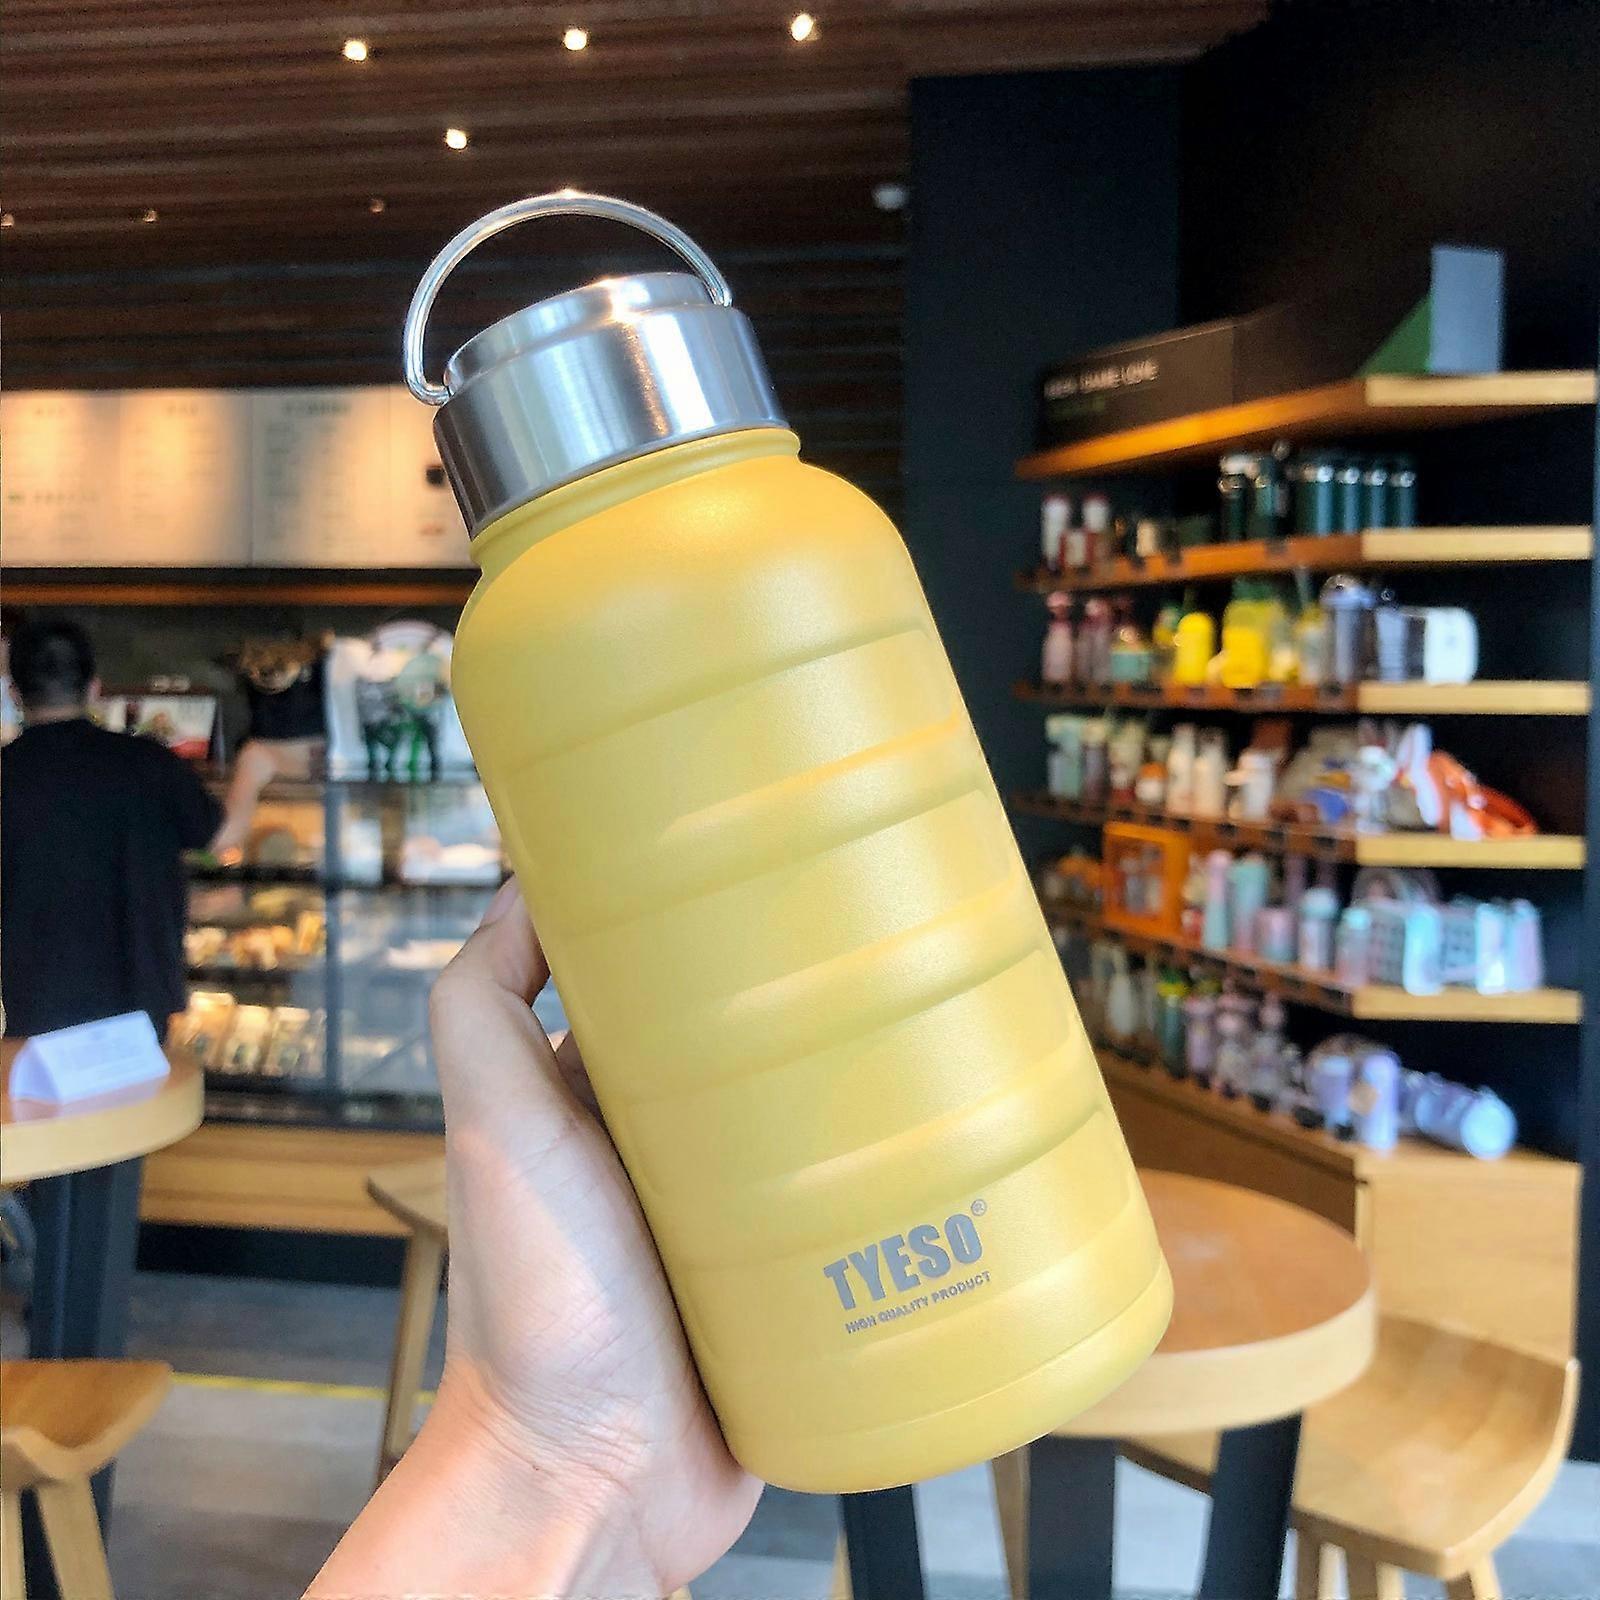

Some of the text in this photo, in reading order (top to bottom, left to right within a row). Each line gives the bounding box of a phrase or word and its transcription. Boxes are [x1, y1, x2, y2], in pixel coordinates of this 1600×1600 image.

[845, 1270, 992, 1334] HIGH QUALITY PRODUCT
